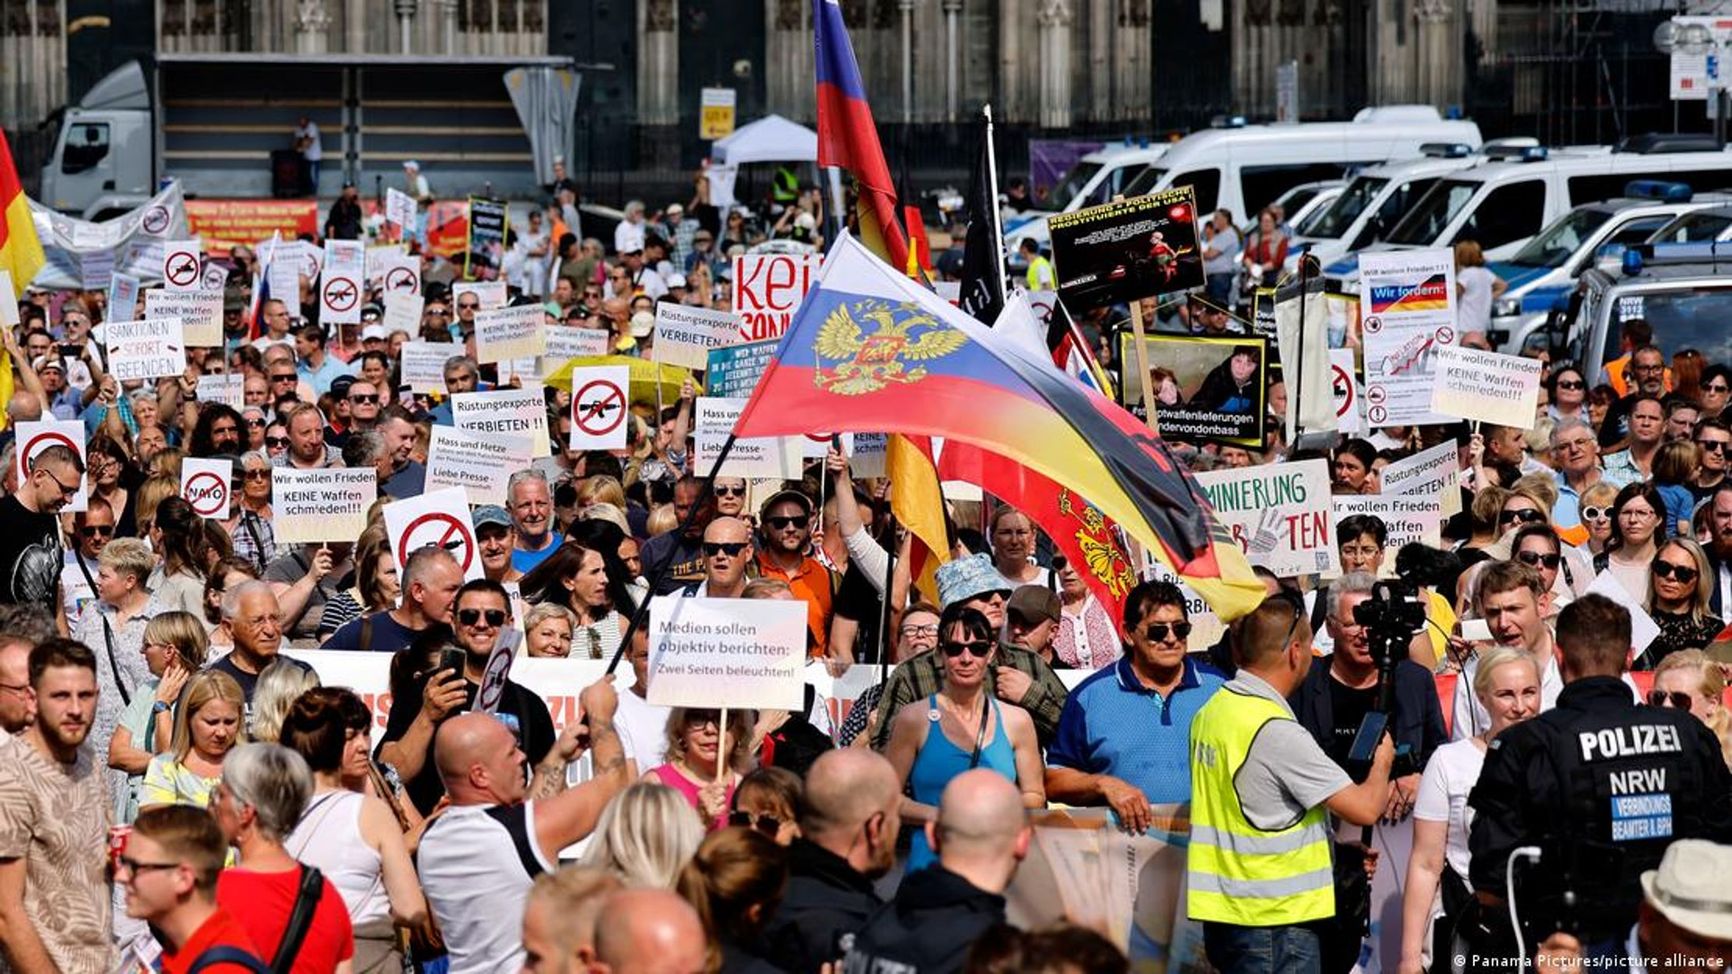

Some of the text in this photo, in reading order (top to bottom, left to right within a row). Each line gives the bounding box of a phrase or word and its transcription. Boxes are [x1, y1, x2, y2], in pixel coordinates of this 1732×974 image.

[1164, 196, 1187, 206] USA
[737, 254, 825, 310] Kei
[1374, 286, 1444, 298] Wir fordern:
[154, 306, 212, 315] KEINE Waffen
[661, 309, 739, 331] Rüstungsexporte
[108, 321, 170, 339] SANKTIONEN
[483, 325, 505, 334] KEINE
[660, 329, 721, 346] VERBIETEN
[122, 340, 161, 357] SOFORT
[116, 358, 176, 378] BEENDEN
[1440, 348, 1541, 374] Wir wollen Frieden
[1447, 367, 1481, 381] KEINE
[1484, 372, 1524, 389] Waffen
[457, 397, 543, 412] Rüstungsexporte
[703, 409, 740, 419] Hass un
[1158, 422, 1240, 436] ndervondonbass
[437, 437, 506, 453] Hass und Hetze
[702, 443, 724, 453] Lieb
[433, 468, 459, 478] Liebe
[460, 470, 490, 482] Presse
[1385, 449, 1457, 487] Rüstungsexporte
[274, 472, 376, 484] Wir wollen Frieden
[190, 487, 222, 500] NATO
[284, 490, 362, 502] KEINE Waffen
[1202, 473, 1307, 513] MINIERUNG
[1348, 500, 1388, 512] wollen
[1392, 500, 1440, 512] Frieden
[1385, 520, 1423, 532] affen
[659, 621, 757, 636] Medien sollen
[658, 640, 791, 656] objektiv berichten:
[657, 662, 795, 678] Zwei Seiten beleuchten!
[1579, 724, 1682, 762] POLIZEI
[1609, 767, 1666, 795] NRW
[1616, 794, 1672, 818] VERBINDUNGS
[1612, 818, 1649, 841] BEAMTER
